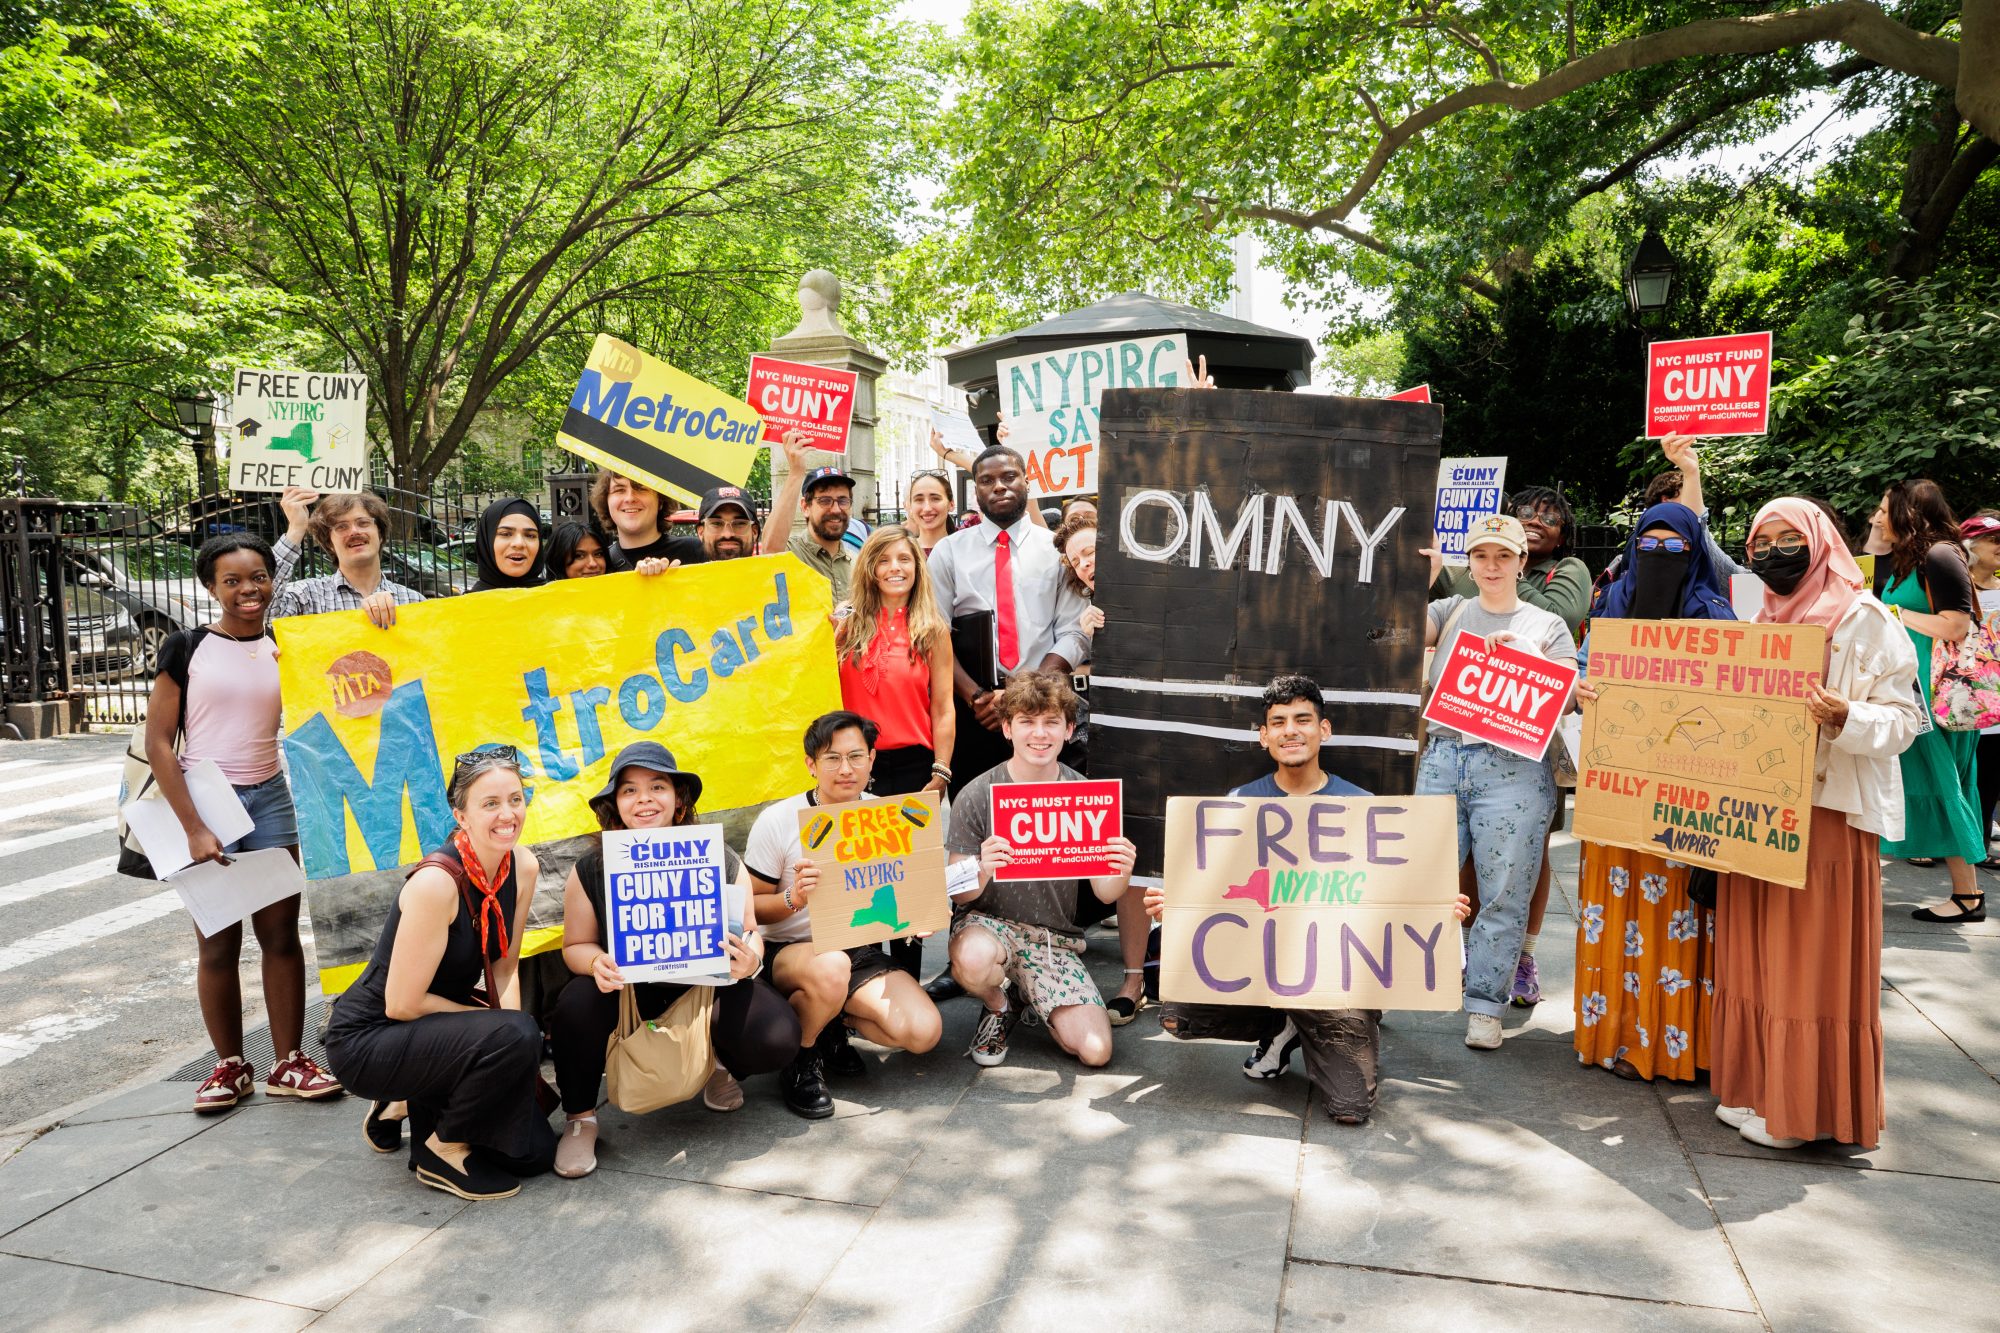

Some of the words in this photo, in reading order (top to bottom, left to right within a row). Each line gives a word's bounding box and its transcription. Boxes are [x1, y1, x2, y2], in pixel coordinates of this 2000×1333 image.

[601, 344, 635, 375] MTA
[1656, 356, 1682, 367] NYC
[1685, 352, 1723, 364] MUST
[1726, 349, 1763, 362] FUND
[237, 371, 299, 398] FREE
[308, 376, 365, 400] CUNY
[756, 370, 779, 381] NYC
[783, 374, 815, 387] MUST
[818, 380, 849, 392] FUND
[1010, 339, 1177, 417] NYPIRG
[1663, 364, 1757, 402] CUNY
[267, 401, 324, 421] NYPIRG
[569, 368, 760, 445] MetroCard
[762, 384, 843, 421] CUNY
[1653, 404, 1709, 414] COMMUNITY
[1710, 401, 1760, 412] COLLEGES
[1654, 414, 1690, 423] PSC/CUNY
[1699, 411, 1759, 421] #FundCUNYNow
[802, 421, 842, 433] COLLEGES
[241, 463, 302, 487] FREE
[311, 466, 363, 490] CUNY
[1026, 444, 1093, 495] ACT
[1453, 468, 1498, 481] CUNY
[1440, 489, 1480, 509] CUNY
[1479, 489, 1495, 509] IS
[1120, 489, 1406, 582] OMNY
[1437, 510, 1464, 530] FOR
[1438, 531, 1467, 553] PEO
[1630, 624, 1744, 657] INVEST
[1760, 634, 1793, 661] IN
[1458, 646, 1486, 663] NYC
[1487, 656, 1527, 677] MUST
[1527, 670, 1565, 691] FUND
[1589, 652, 1708, 687] STUDENTS'
[1716, 664, 1821, 698] FUTURES
[326, 672, 381, 706] MTA
[1457, 664, 1554, 720] CUNY
[1438, 700, 1475, 719] PSC/CUNY
[1481, 717, 1540, 743] #FundCUNYNow
[1440, 692, 1496, 717] COMMUNITY
[1496, 713, 1545, 736] COLLEGES
[999, 798, 1028, 809] NYC
[1032, 797, 1072, 808] MUST
[1076, 795, 1114, 806] FUND
[1585, 769, 1650, 798] FULLY
[1657, 783, 1710, 811] FUND
[1719, 796, 1779, 826] CUNY
[1780, 808, 1800, 832] &
[842, 805, 899, 838] FREE
[1010, 809, 1108, 844] CUNY
[1196, 800, 1409, 871] FREE
[1653, 802, 1758, 843] FINANCIAL
[1766, 829, 1800, 854] AID
[631, 839, 711, 862] CUNY
[836, 826, 911, 862] CUNY
[1052, 855, 1107, 863] #FundCUNYNo
[1674, 829, 1720, 859] NYPIRG
[634, 861, 666, 869] RISING
[668, 858, 710, 867] ALLIANCE
[844, 860, 904, 891] NYPIRG
[617, 871, 684, 901] CUNY
[690, 868, 715, 896] IS
[1271, 870, 1367, 905] NYPIRG
[618, 903, 666, 932] FOR
[670, 898, 717, 927] THE
[625, 929, 714, 963] PEOPLE
[1191, 913, 1443, 997] CUNY
